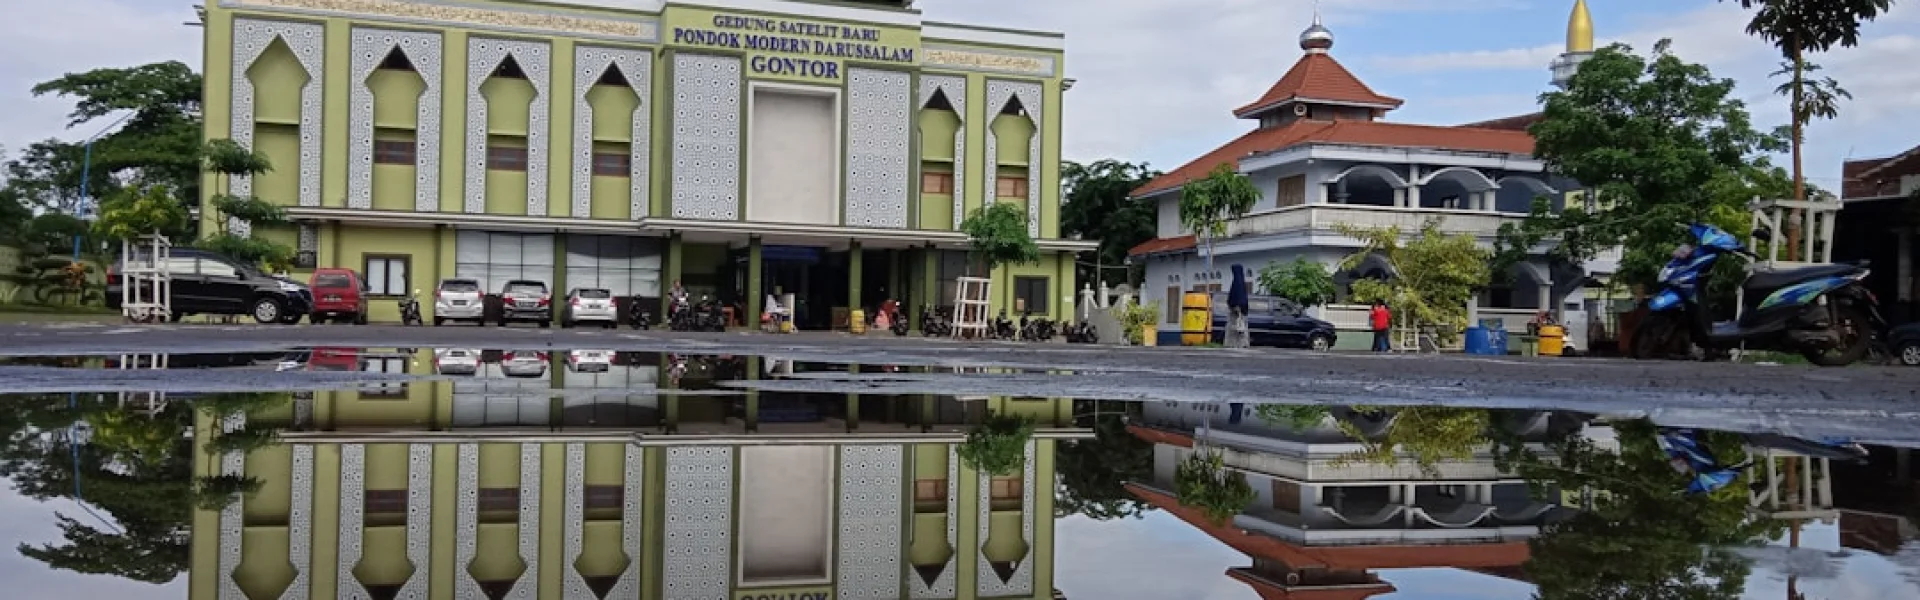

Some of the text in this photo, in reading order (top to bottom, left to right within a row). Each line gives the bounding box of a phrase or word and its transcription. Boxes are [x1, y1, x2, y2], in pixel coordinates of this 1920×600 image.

[713, 15, 880, 42] GEDUNG SATELIT BARU
[674, 27, 741, 49] PONDOK
[744, 37, 810, 54] MODERN
[813, 45, 913, 62] DARUSSALAM
[751, 55, 839, 78] GONTOR
